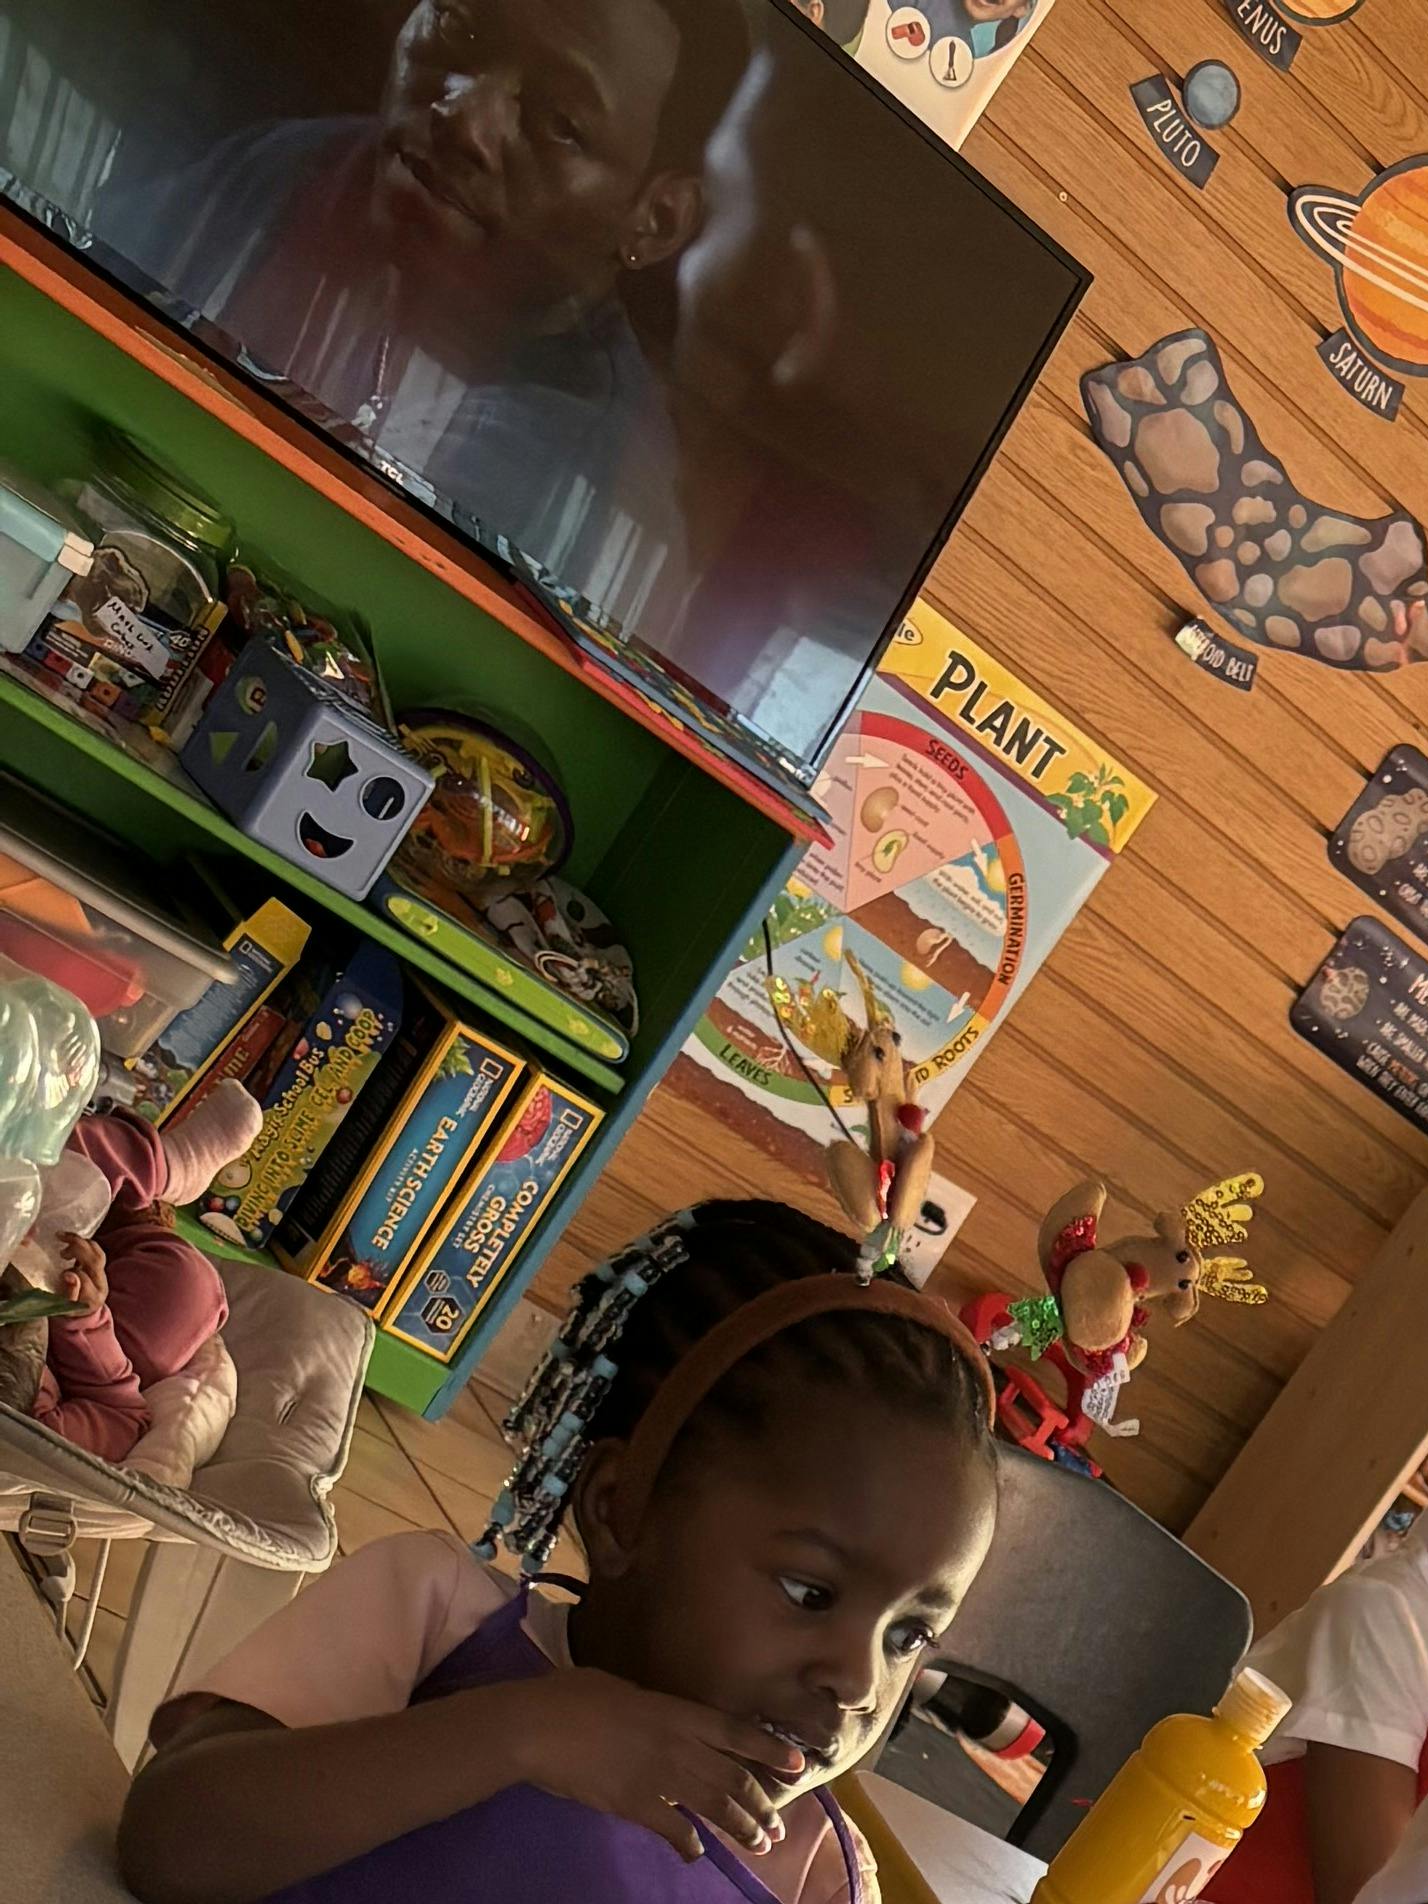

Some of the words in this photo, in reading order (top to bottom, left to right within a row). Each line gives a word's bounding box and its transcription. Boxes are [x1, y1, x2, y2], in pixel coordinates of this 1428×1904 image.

[1237, 0, 1287, 55] ENUS
[1146, 98, 1203, 169] PLUTO
[1329, 342, 1393, 411] SATURN
[378, 459, 407, 485] TCL
[1225, 657, 1254, 681] BELT
[928, 649, 1068, 782] PLANT
[922, 738, 972, 780] SEEDS
[997, 871, 1027, 986] GERMINATION
[719, 1044, 774, 1087] LEAVES
[932, 1025, 980, 1072] ROOTS
[273, 1069, 310, 1116] School
[298, 1044, 325, 1075] Bus
[261, 1147, 292, 1185] INTO
[326, 1046, 355, 1079] AND
[392, 1147, 419, 1187] ACTIVITY
[410, 1114, 458, 1180] EARTH
[369, 1175, 423, 1251] SCIENCE
[383, 1187, 396, 1203] KIT
[461, 1181, 495, 1232] CHEMISTRY
[451, 1231, 465, 1248] SET
[462, 1192, 508, 1255] GROSS
[463, 1175, 540, 1290] COMPLETELY
[432, 1302, 460, 1333] 20
